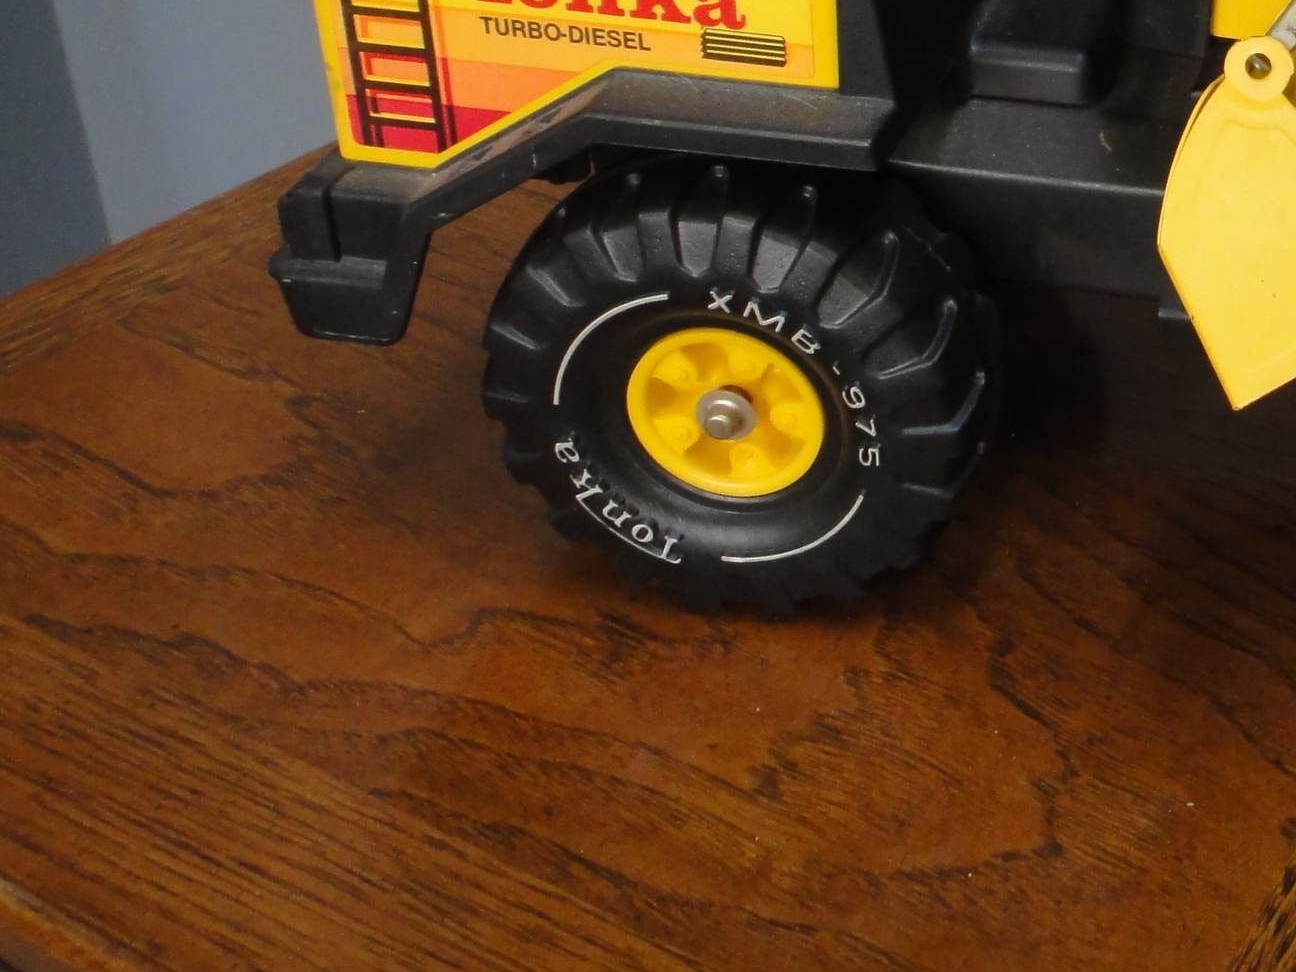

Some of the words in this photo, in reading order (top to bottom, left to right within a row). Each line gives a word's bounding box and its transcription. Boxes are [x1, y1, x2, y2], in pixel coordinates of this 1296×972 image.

[480, 16, 652, 52] TURBO-DIESEL
[706, 287, 881, 468] XMB-975
[555, 439, 683, 564] Tonka
